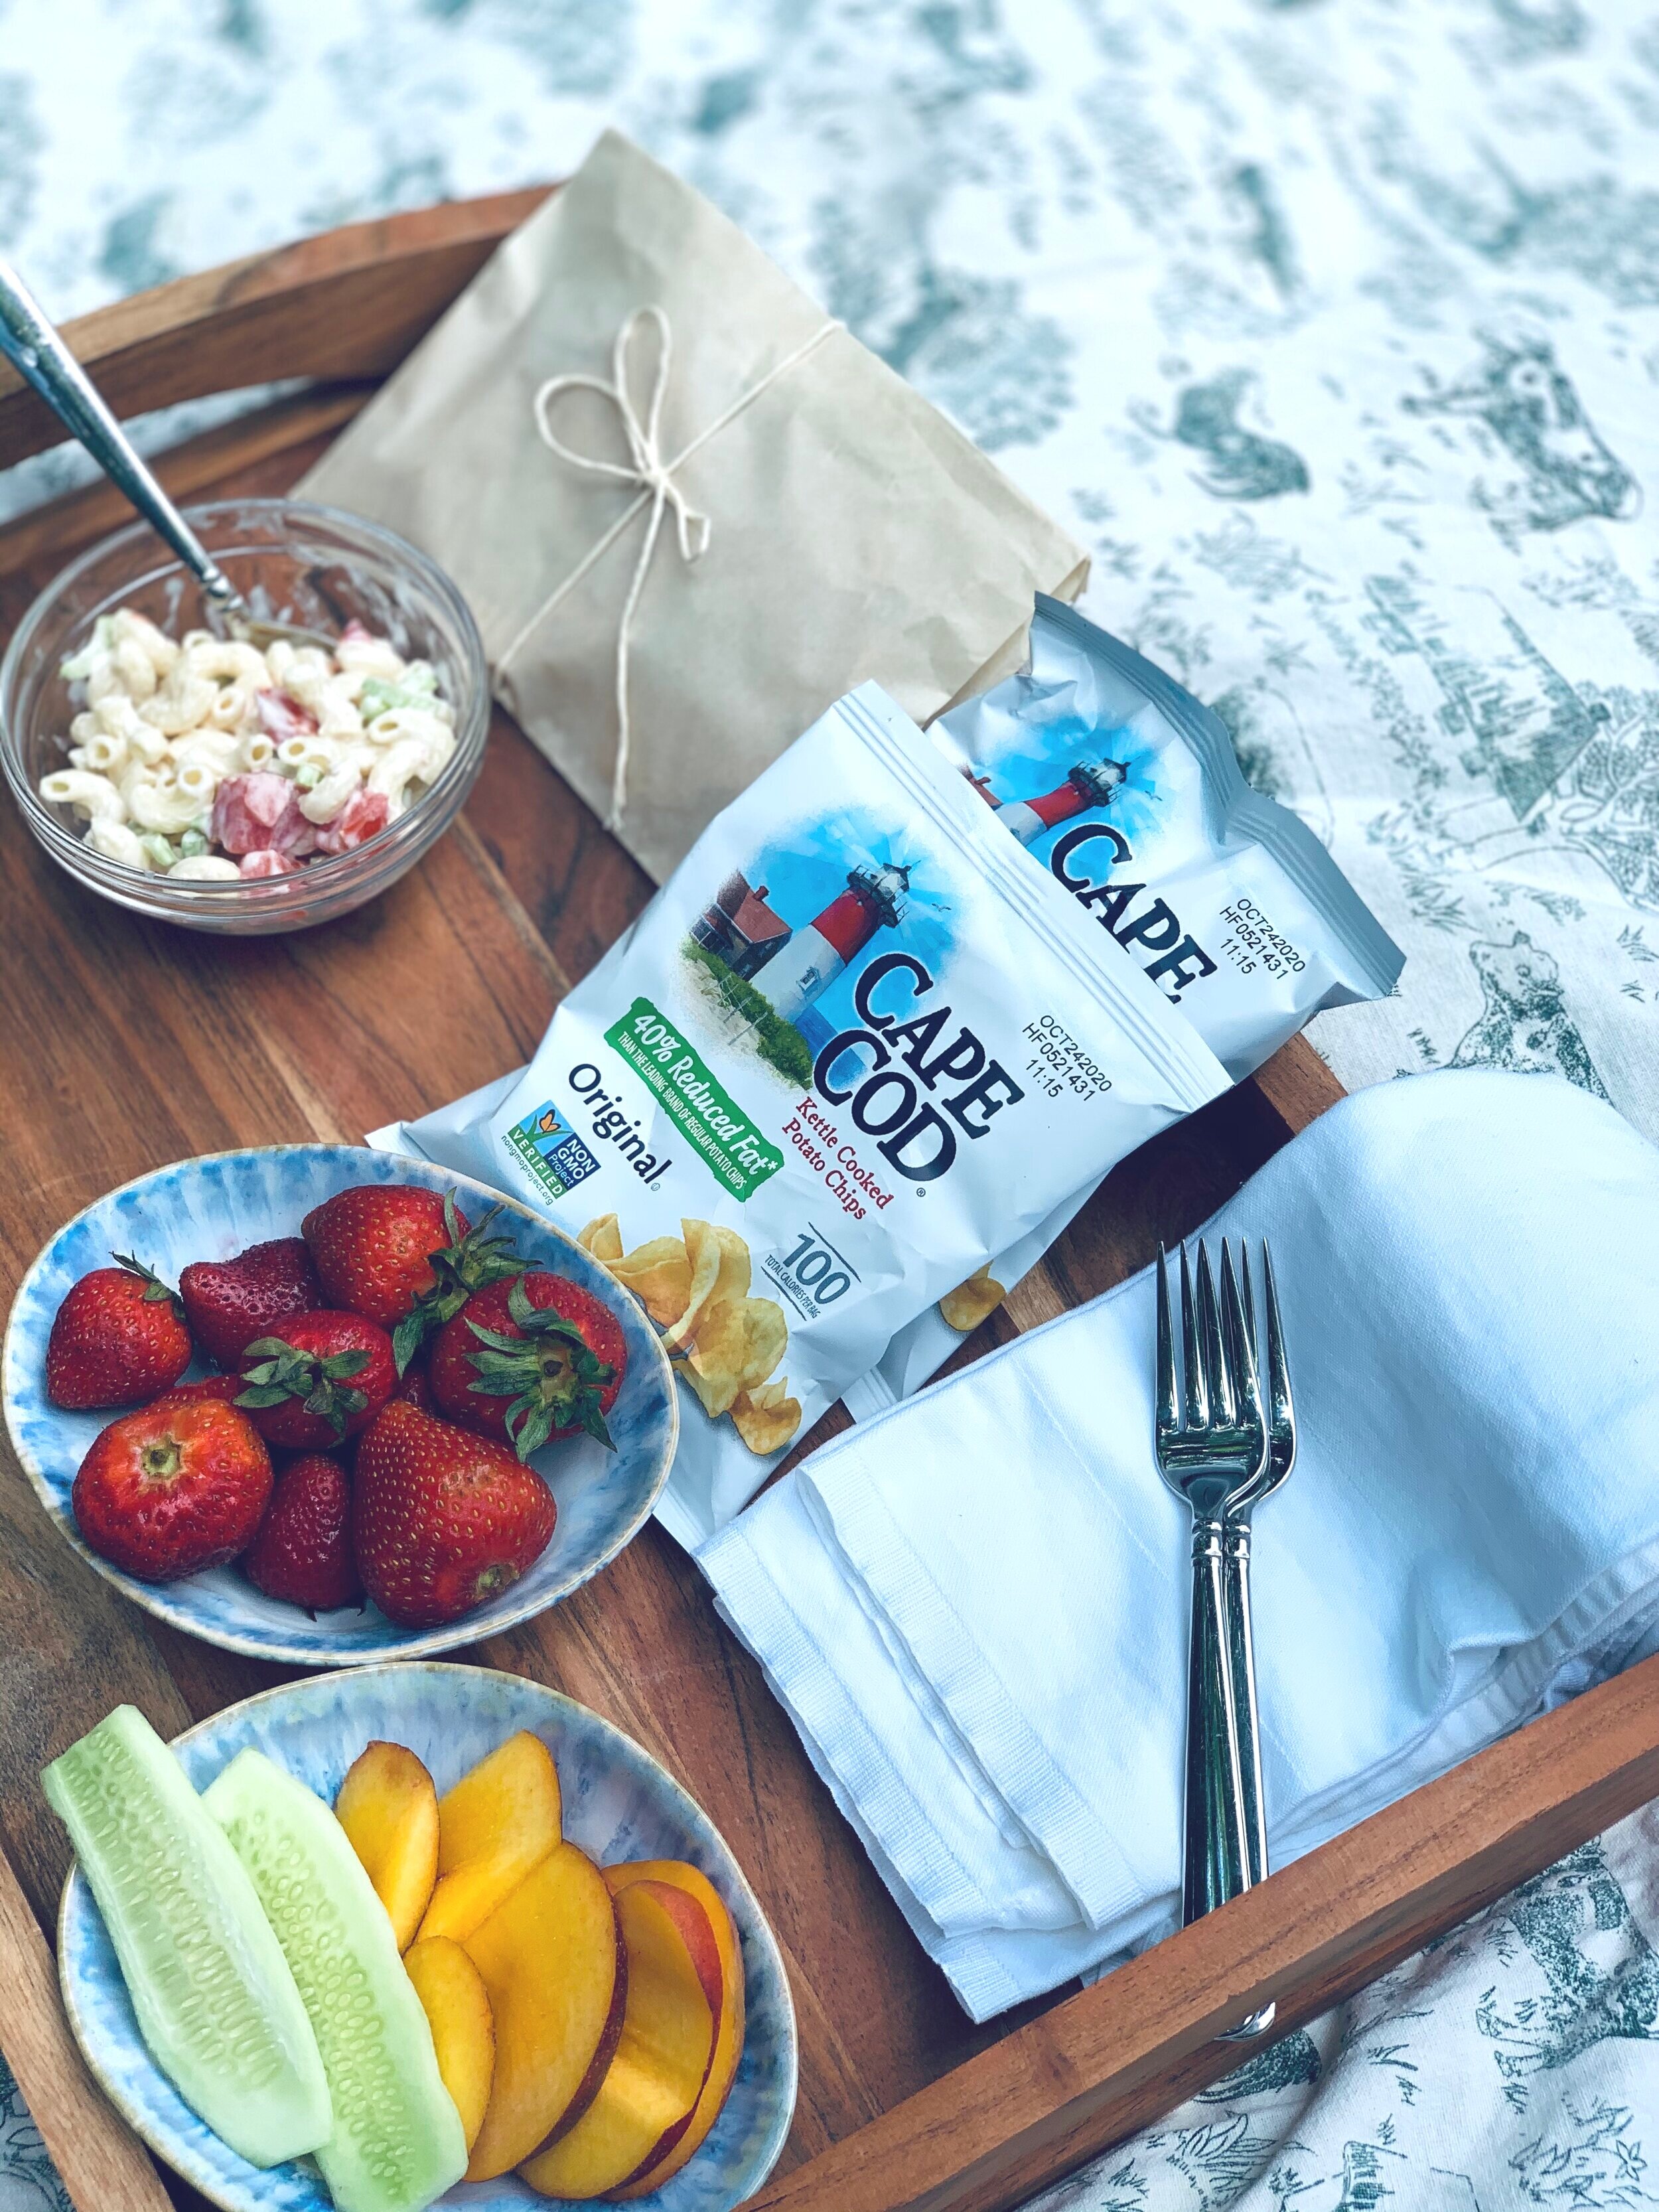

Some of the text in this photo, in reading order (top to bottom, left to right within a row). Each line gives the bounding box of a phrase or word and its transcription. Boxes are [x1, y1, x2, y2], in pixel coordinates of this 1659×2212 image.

[1051, 824, 1218, 1004] CAPE
[1219, 906, 1289, 980] HF0521431
[1237, 899, 1306, 972] OCT242020
[1220, 938, 1257, 974] 11:15
[634, 1015, 681, 1063] 40%
[667, 1055, 745, 1142] Reduced
[854, 952, 1025, 1140] CAPE
[1022, 1023, 1096, 1101] HF0521431
[1026, 1060, 1063, 1097] 11:15
[1040, 1015, 1112, 1092] OCT242020
[568, 1063, 673, 1185] Original
[617, 1031, 747, 1189] THAN THE LEADING BRAND OF REGULAR POTATO CHIPS
[813, 1029, 957, 1182] COD
[501, 1135, 553, 1206] nongmoproject.org
[513, 1129, 563, 1195] VERIFIED
[548, 1153, 575, 1187] Project
[557, 1147, 585, 1179] GMO
[567, 1139, 596, 1173] NON
[782, 1117, 867, 1220] Potato Chips
[796, 1096, 895, 1209] Kettle Cooked
[764, 1254, 821, 1319] TOTAL CALORIES PER BAG
[782, 1233, 851, 1305] 100
